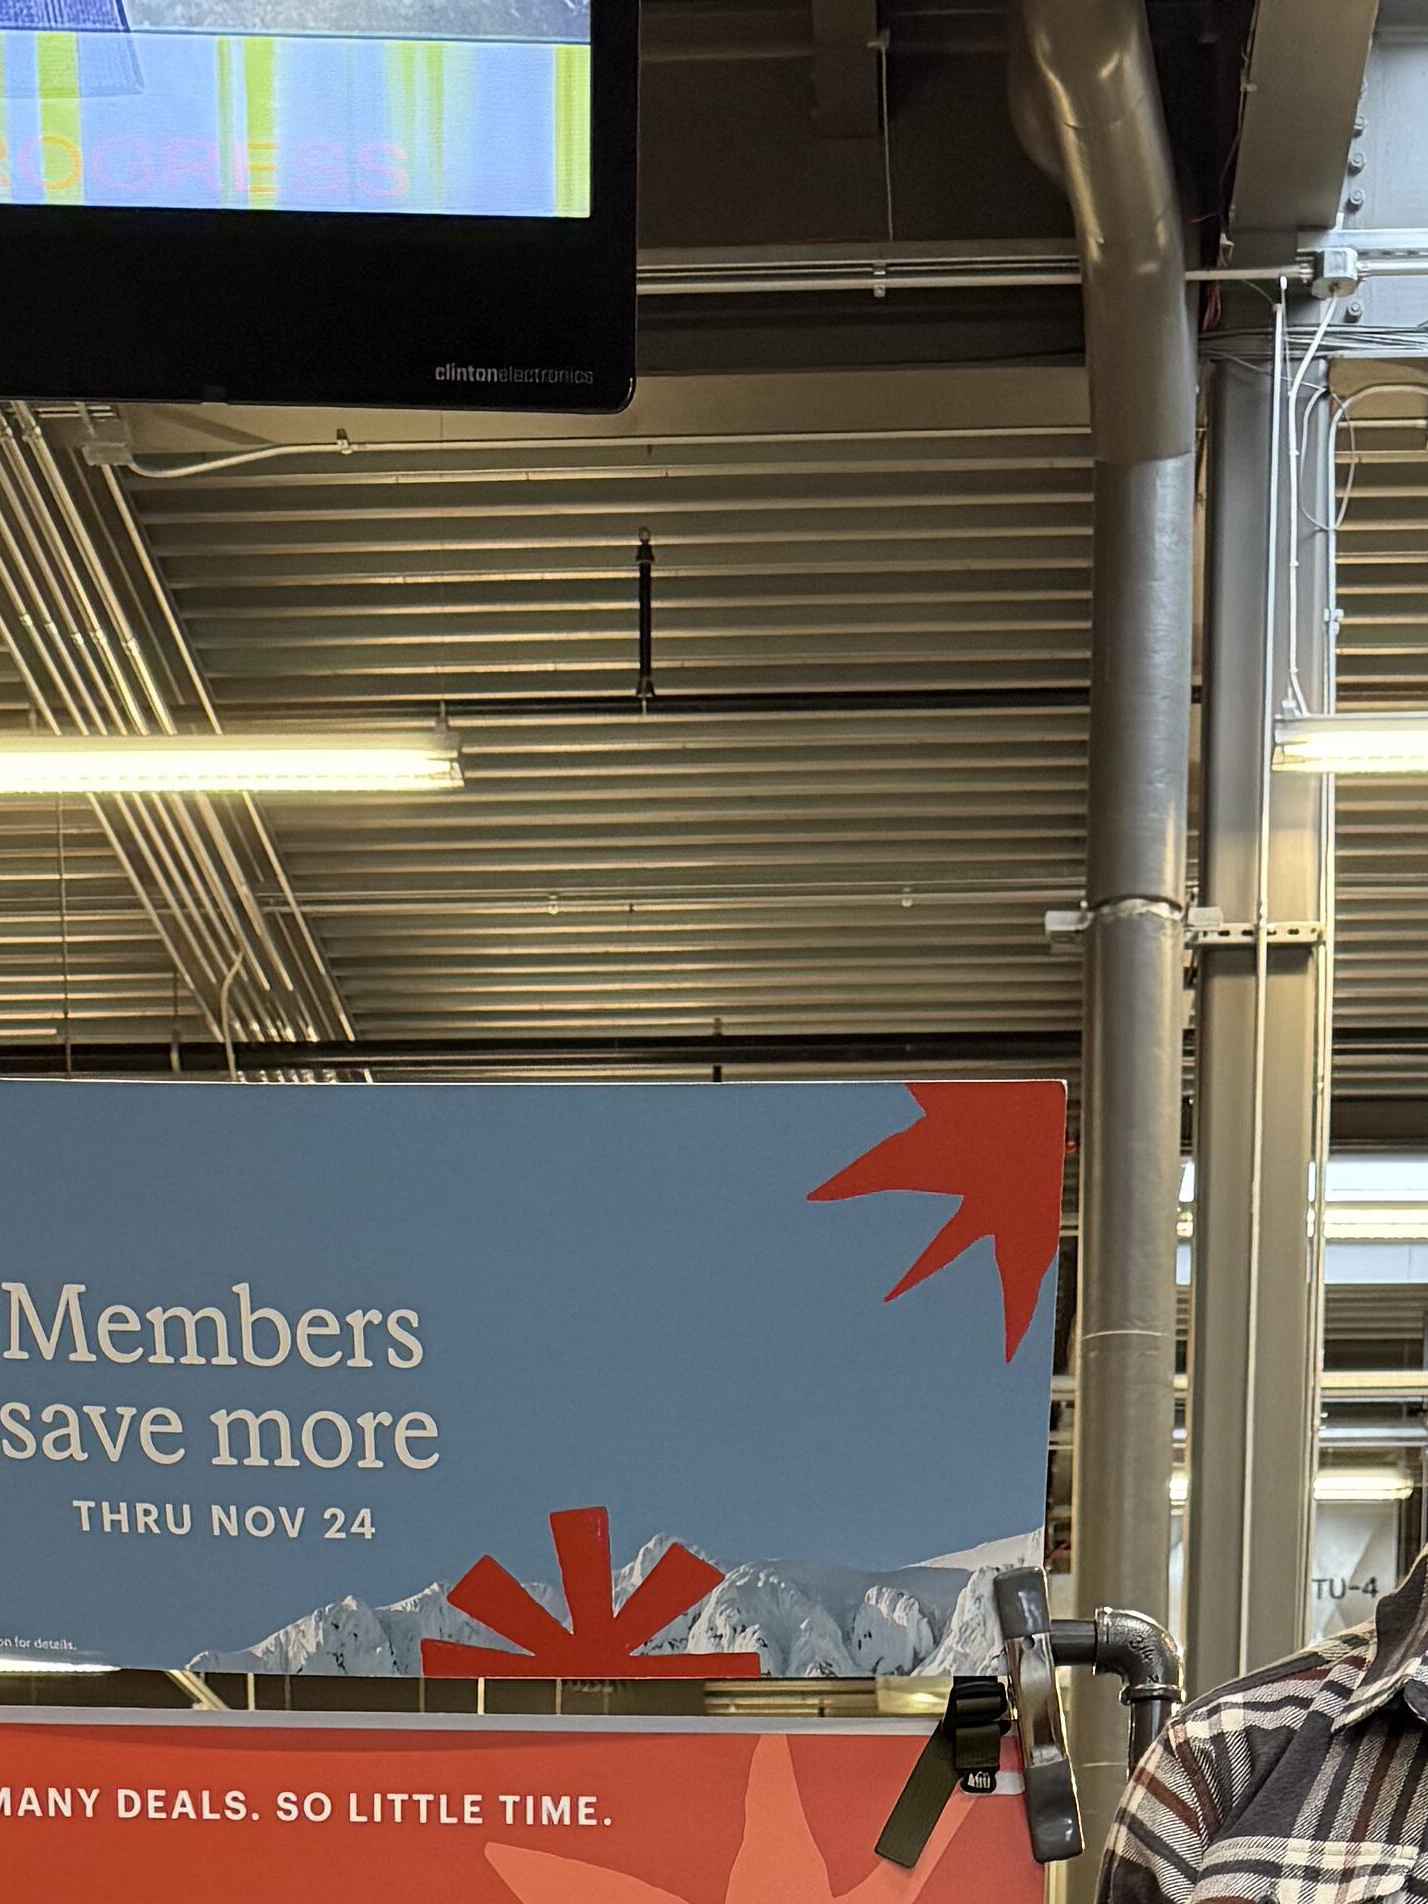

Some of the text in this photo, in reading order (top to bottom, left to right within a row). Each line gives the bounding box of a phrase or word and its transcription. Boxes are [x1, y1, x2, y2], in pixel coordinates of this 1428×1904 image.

[2, 1282, 424, 1369] Members
[0, 1402, 440, 1470] save more
[73, 1500, 376, 1539] THRU NOV 24
[14, 1635, 30, 1648] for
[117, 1788, 260, 1821] DEALS.
[276, 1791, 332, 1822] SO
[349, 1792, 483, 1824] LITTLE
[498, 1795, 612, 1826] TIME.
